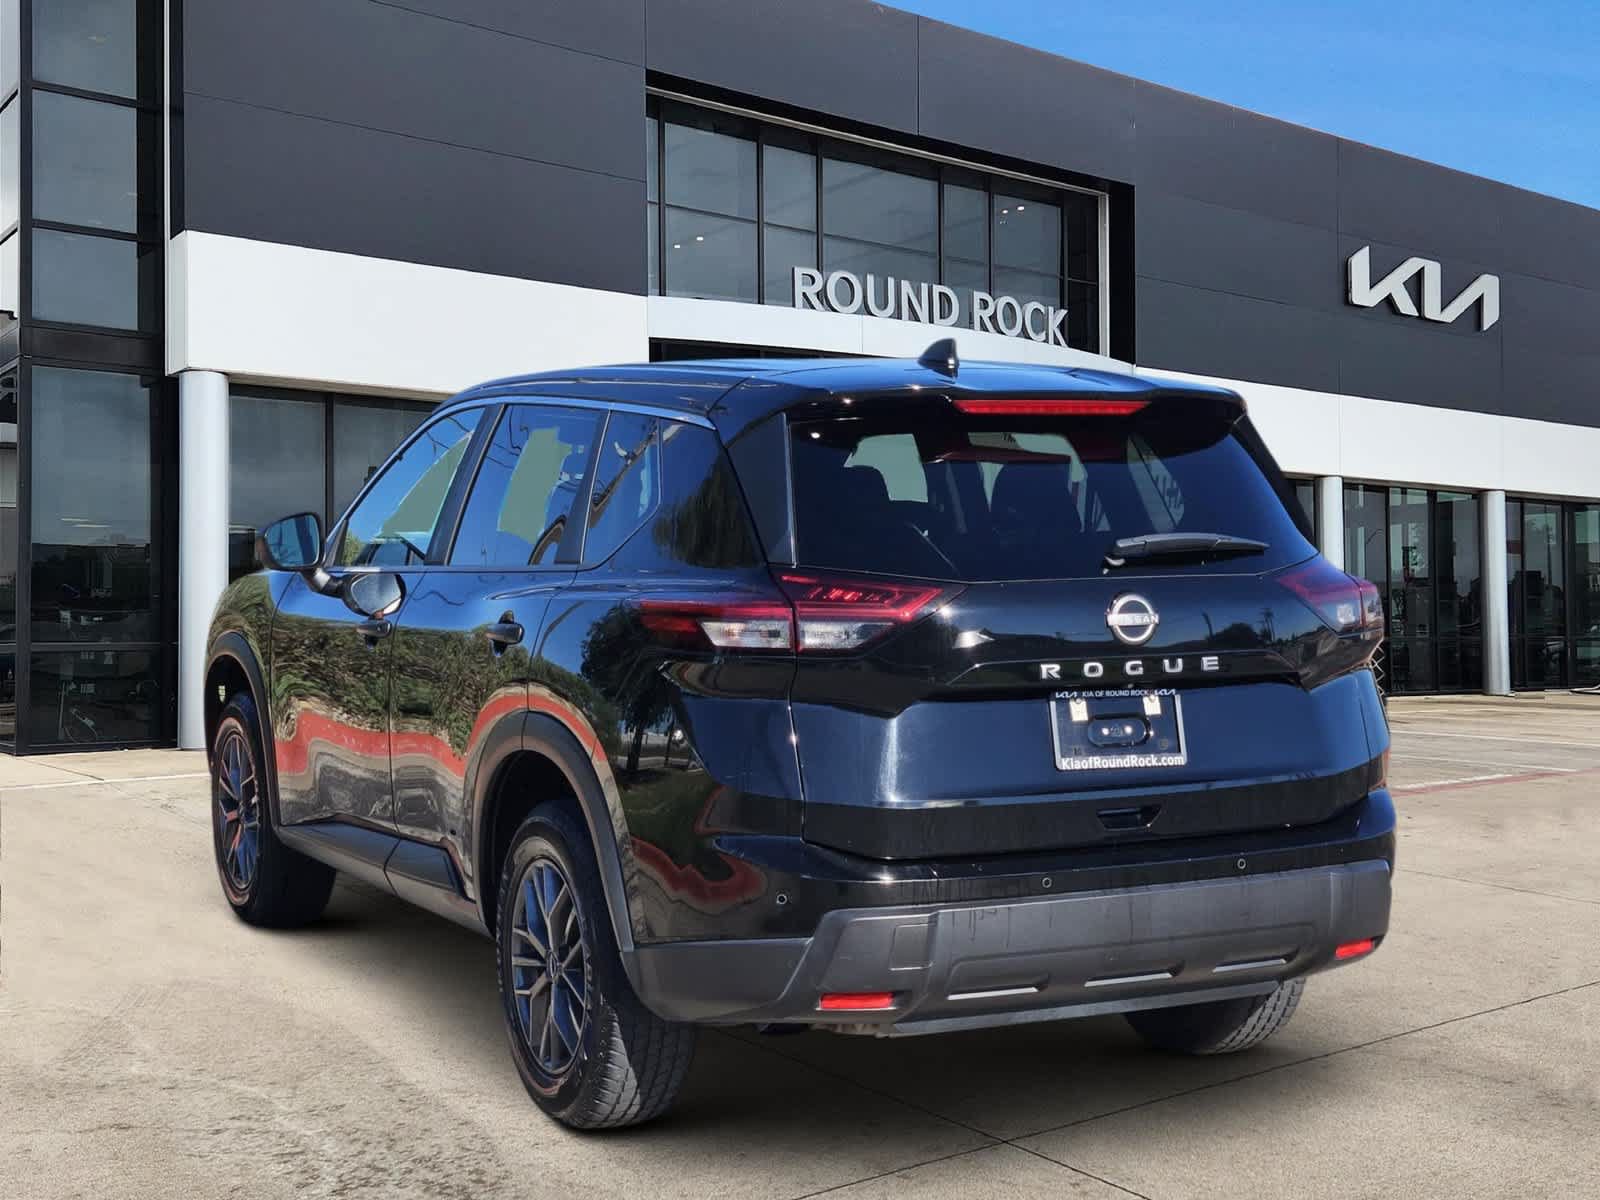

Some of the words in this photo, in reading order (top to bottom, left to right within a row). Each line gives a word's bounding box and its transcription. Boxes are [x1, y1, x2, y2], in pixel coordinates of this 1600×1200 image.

[1347, 245, 1500, 332] KIA
[791, 266, 960, 327] ROUND
[970, 290, 1069, 348] ROCK
[1108, 613, 1159, 626] ISSAN
[1040, 656, 1220, 680] ROGUE
[1061, 754, 1184, 770] KiaofRoundRock.com
